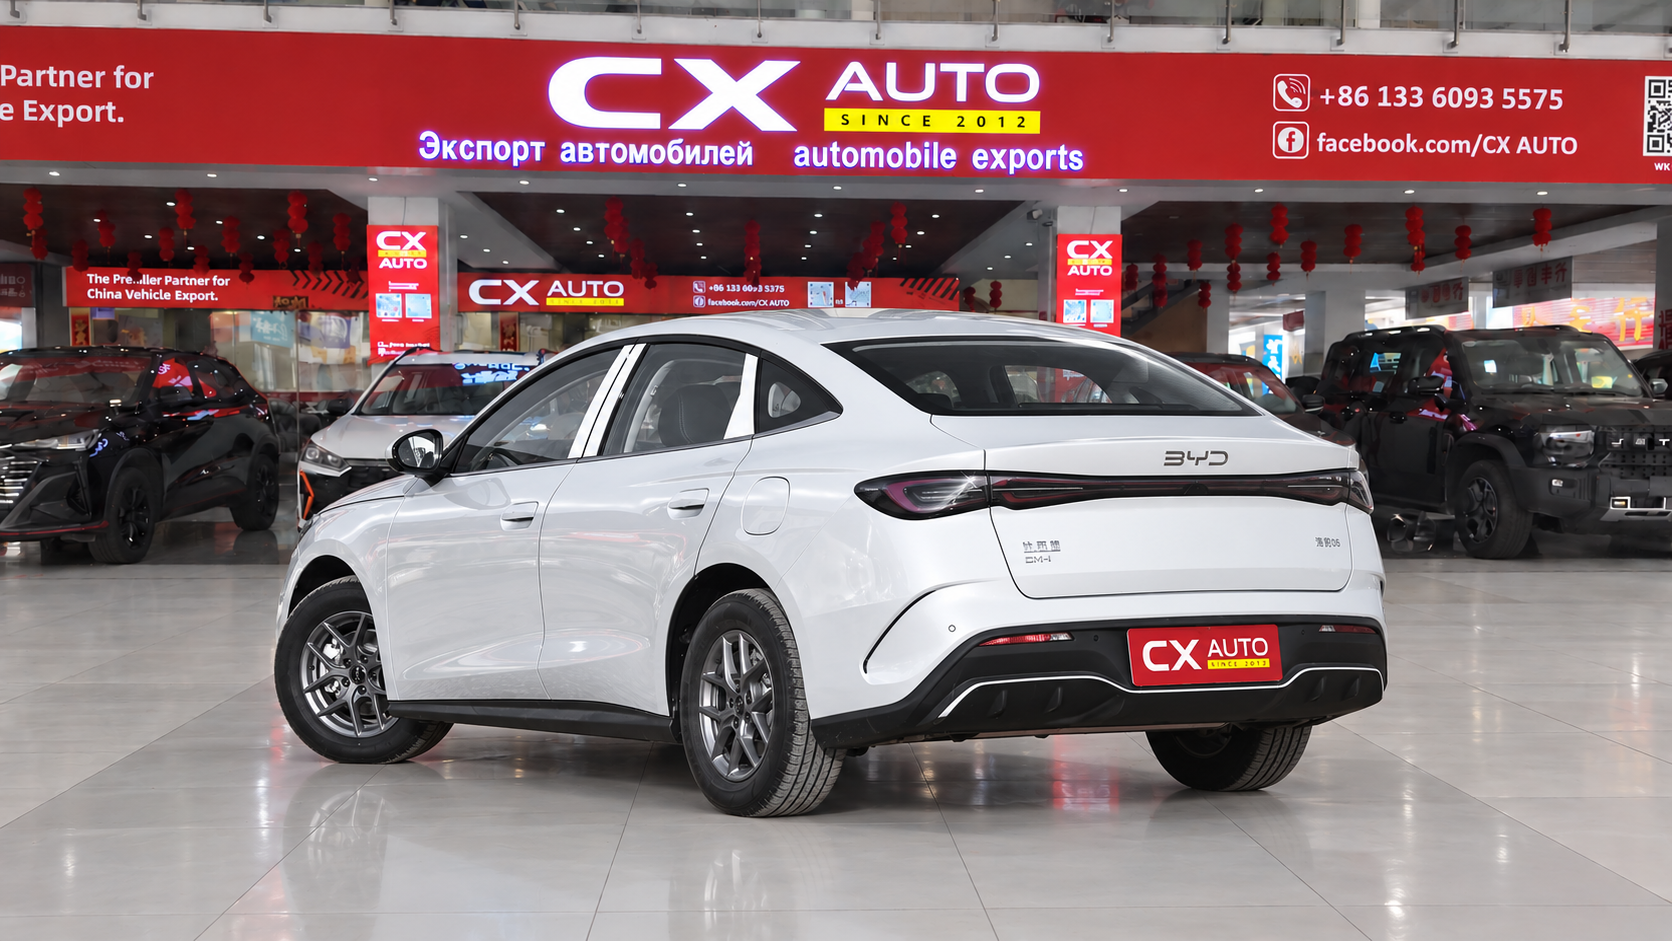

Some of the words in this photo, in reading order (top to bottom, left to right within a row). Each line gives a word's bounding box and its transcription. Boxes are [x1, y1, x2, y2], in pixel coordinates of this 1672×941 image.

[0, 64, 105, 89] Partner
[113, 65, 155, 89] for
[547, 56, 801, 132] CX
[826, 62, 1040, 103] AUTO
[1319, 86, 1369, 107] +86
[1377, 86, 1424, 107] 133
[1432, 87, 1494, 109] 6093
[1501, 88, 1563, 110] 5575
[23, 99, 124, 128] Export.
[840, 113, 931, 127] SINCE
[956, 115, 1026, 128] 2012
[418, 130, 546, 168] Экспорт
[560, 136, 753, 167] автомобилей
[1317, 132, 1510, 158] facebook.com/CX
[1515, 136, 1578, 155] AUTO
[794, 141, 957, 169] automobile
[972, 143, 1085, 176] exports
[376, 231, 427, 251] CX
[1066, 240, 1113, 259] CX
[378, 257, 427, 269] AUTO
[1067, 265, 1113, 276] AUTO
[86, 273, 110, 285] The
[164, 275, 211, 287] Partner
[212, 275, 231, 287] for
[86, 287, 123, 300] China
[124, 288, 173, 301] Vehicle
[174, 290, 219, 304] Export.
[469, 279, 540, 306] CX
[547, 279, 625, 297] AUTO
[769, 299, 790, 307] AUTO
[1163, 450, 1229, 466] BYD
[1142, 639, 1202, 672] CX
[1207, 637, 1270, 658] AUTO
